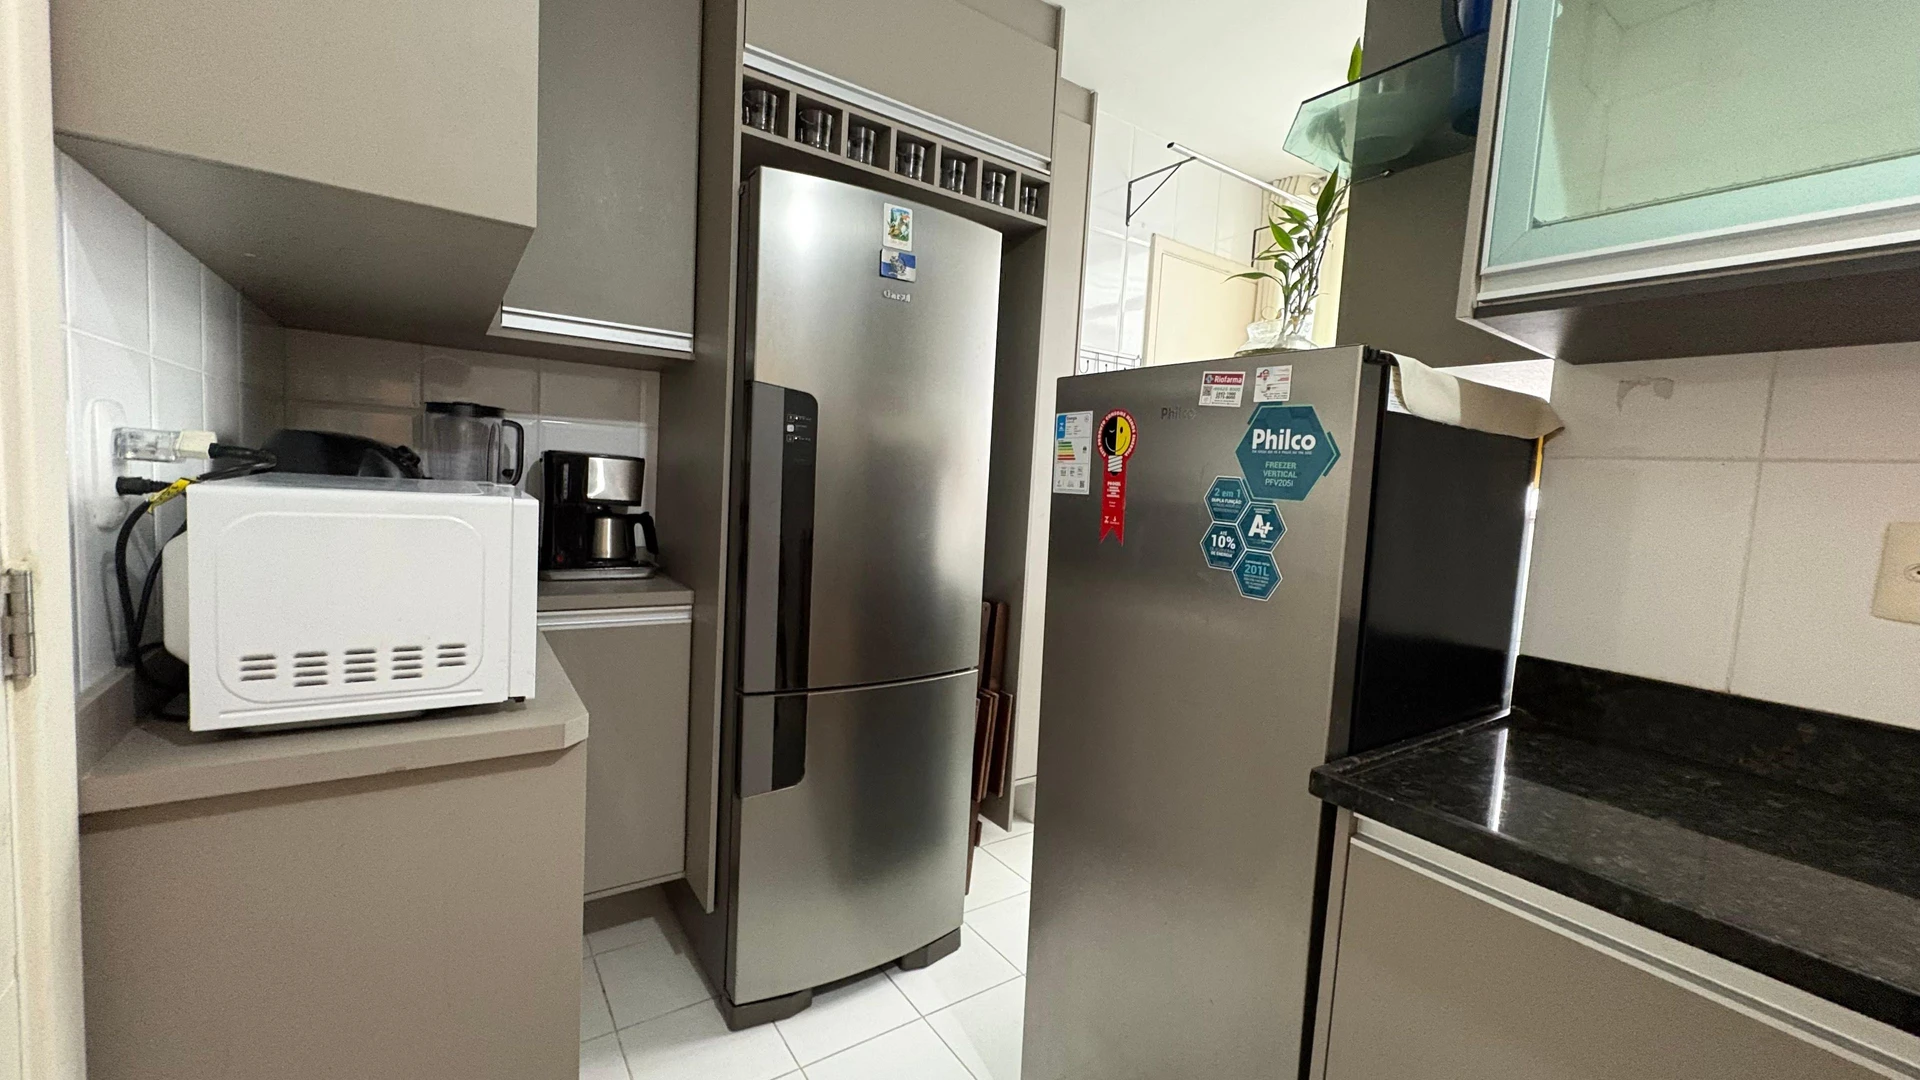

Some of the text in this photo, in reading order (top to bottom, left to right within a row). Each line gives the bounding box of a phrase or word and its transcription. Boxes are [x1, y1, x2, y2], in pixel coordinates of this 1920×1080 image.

[1214, 375, 1243, 384] Riofarma
[1251, 428, 1317, 451] Philco
[1265, 461, 1297, 470] FREEZER
[1263, 470, 1298, 479] VERTICAL
[1213, 487, 1241, 499] 2 em 1
[1248, 514, 1274, 538] A+
[1211, 534, 1236, 550] 10%
[1244, 564, 1270, 577] 201L
